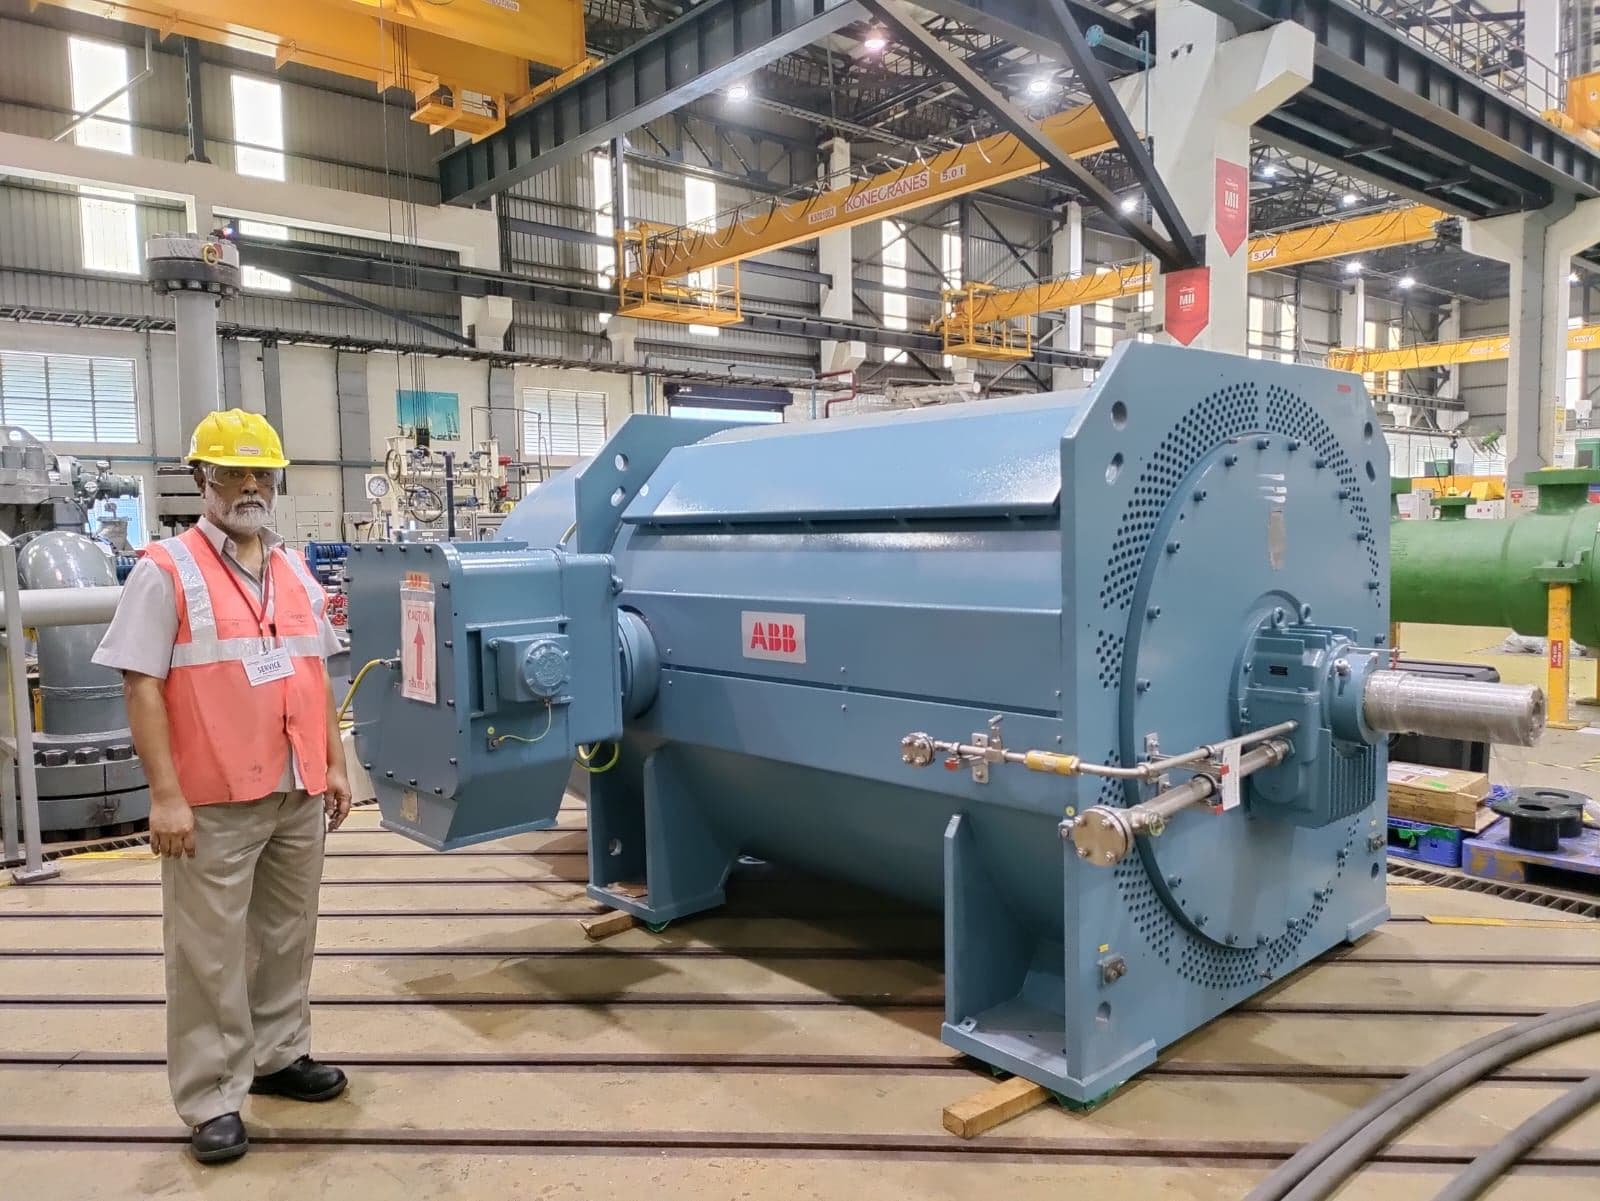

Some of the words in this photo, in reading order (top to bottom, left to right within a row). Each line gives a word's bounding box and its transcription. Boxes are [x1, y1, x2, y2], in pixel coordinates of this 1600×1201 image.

[846, 174, 928, 211] KONECRANES
[751, 621, 797, 653] ABB
[257, 659, 282, 674] SERVICE
